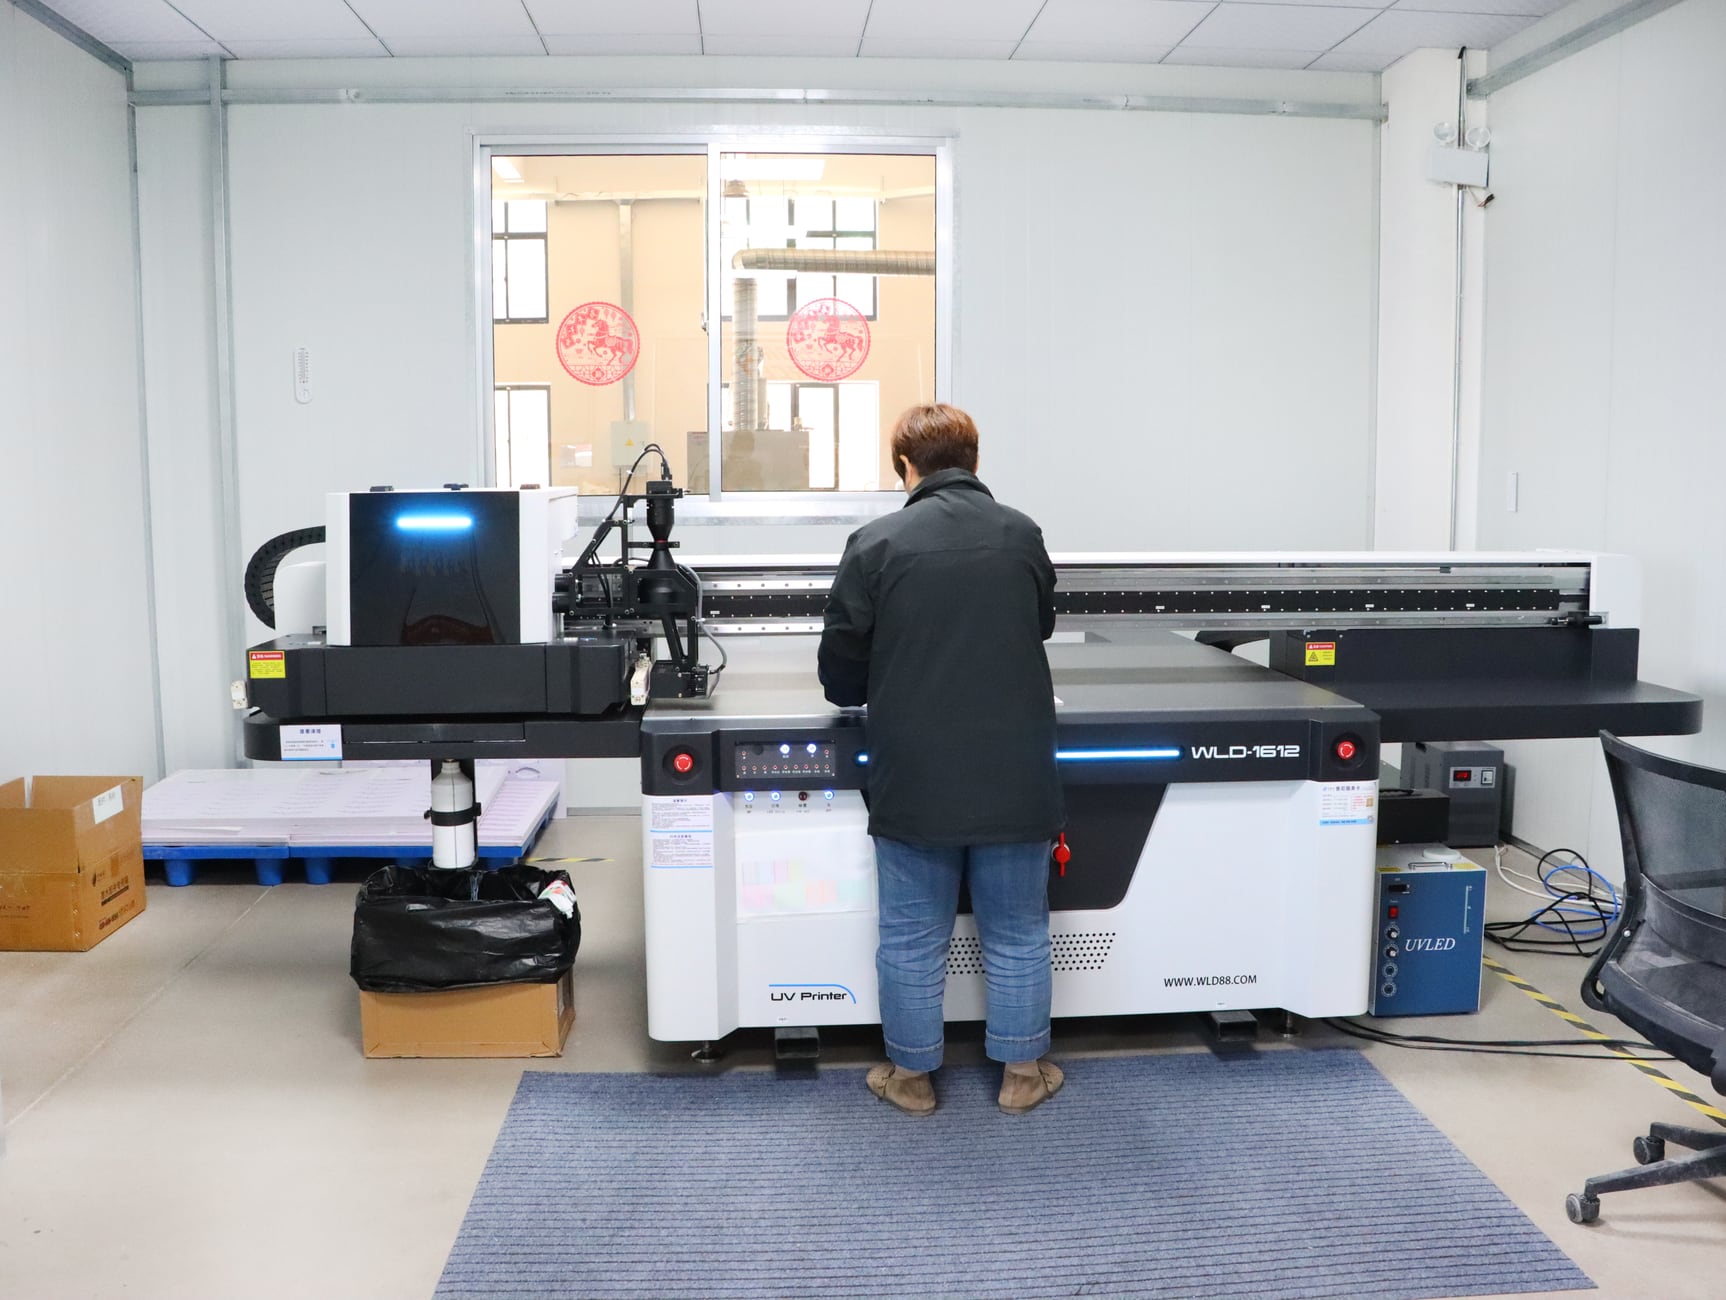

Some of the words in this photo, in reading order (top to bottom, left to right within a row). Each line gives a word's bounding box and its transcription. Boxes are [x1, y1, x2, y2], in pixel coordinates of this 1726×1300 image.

[1191, 745, 1300, 759] WLD-1612
[1405, 937, 1456, 952] UVLED
[1163, 974, 1257, 987] WWW.WLD88.COM
[770, 992, 796, 1001] UV
[800, 991, 848, 1001] Printer
